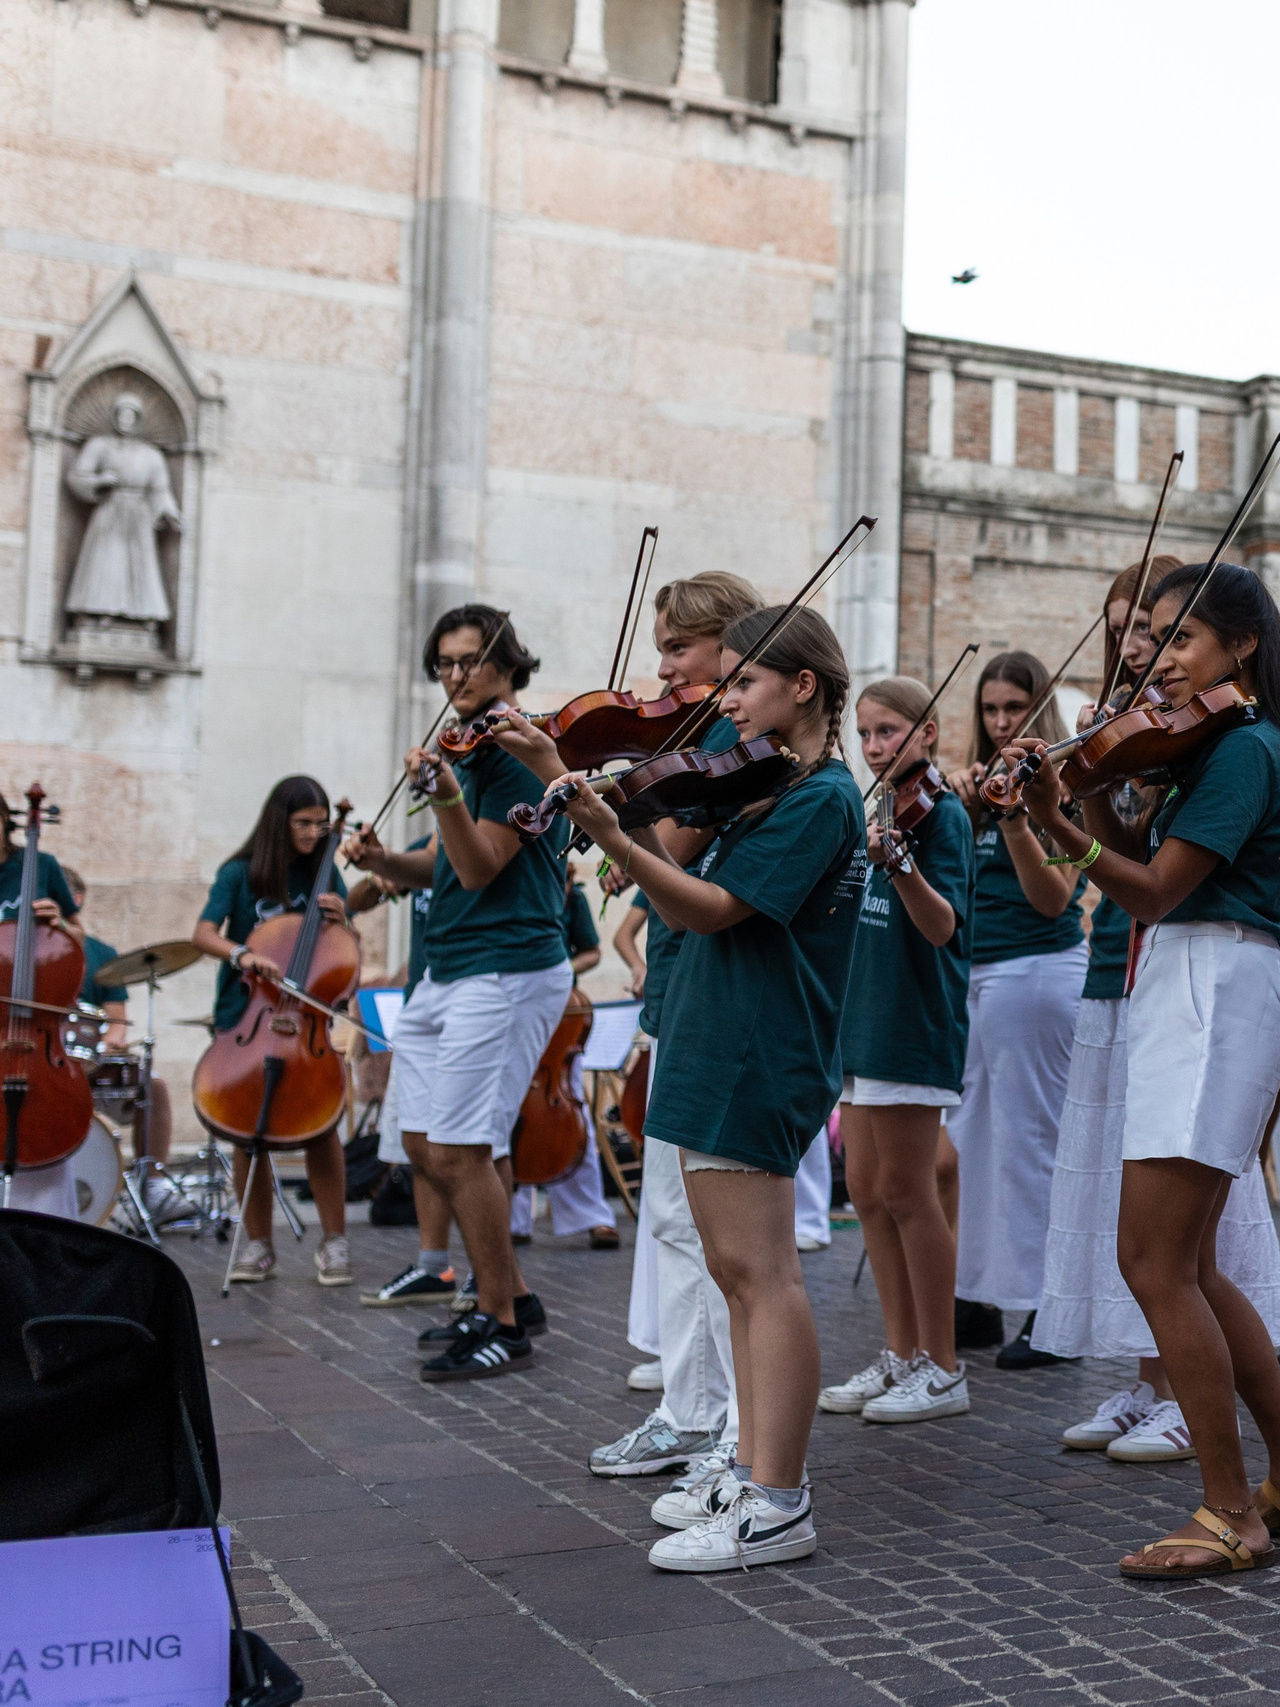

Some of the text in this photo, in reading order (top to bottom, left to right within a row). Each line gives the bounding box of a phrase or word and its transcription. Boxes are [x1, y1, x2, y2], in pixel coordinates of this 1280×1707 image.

[195, 1544, 217, 1553] 202
[40, 1635, 182, 1670] STRING
[0, 1677, 32, 1703] A
